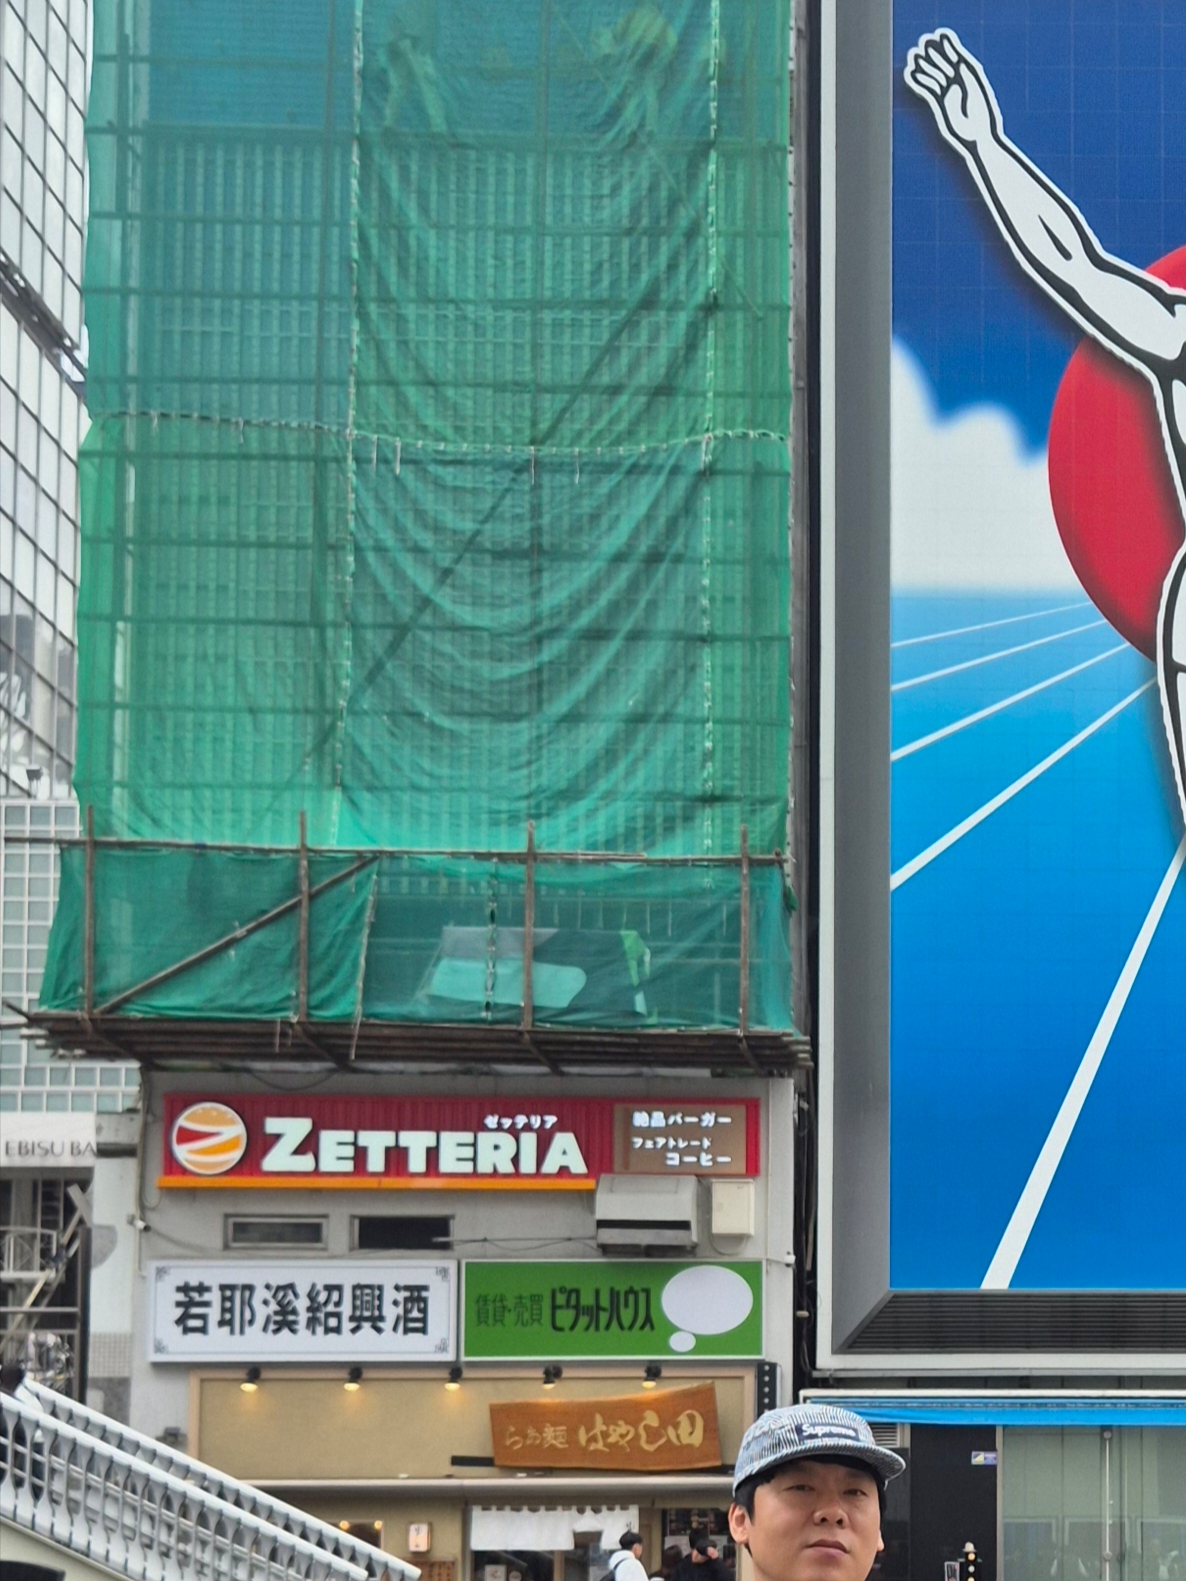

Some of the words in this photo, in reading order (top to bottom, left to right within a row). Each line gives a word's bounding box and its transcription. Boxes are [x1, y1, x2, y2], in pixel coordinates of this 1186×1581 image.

[484, 1114, 558, 1130] ゼッテリア
[632, 1110, 732, 1128] 絶品バーガー
[5, 1140, 65, 1157] EBISU
[261, 1117, 588, 1175] ZETTERIA
[632, 1136, 712, 1149] フェアトレード
[665, 1152, 732, 1167] コーヒー
[551, 1286, 656, 1333] ピタットハウス
[801, 1423, 857, 1438] Supreme
